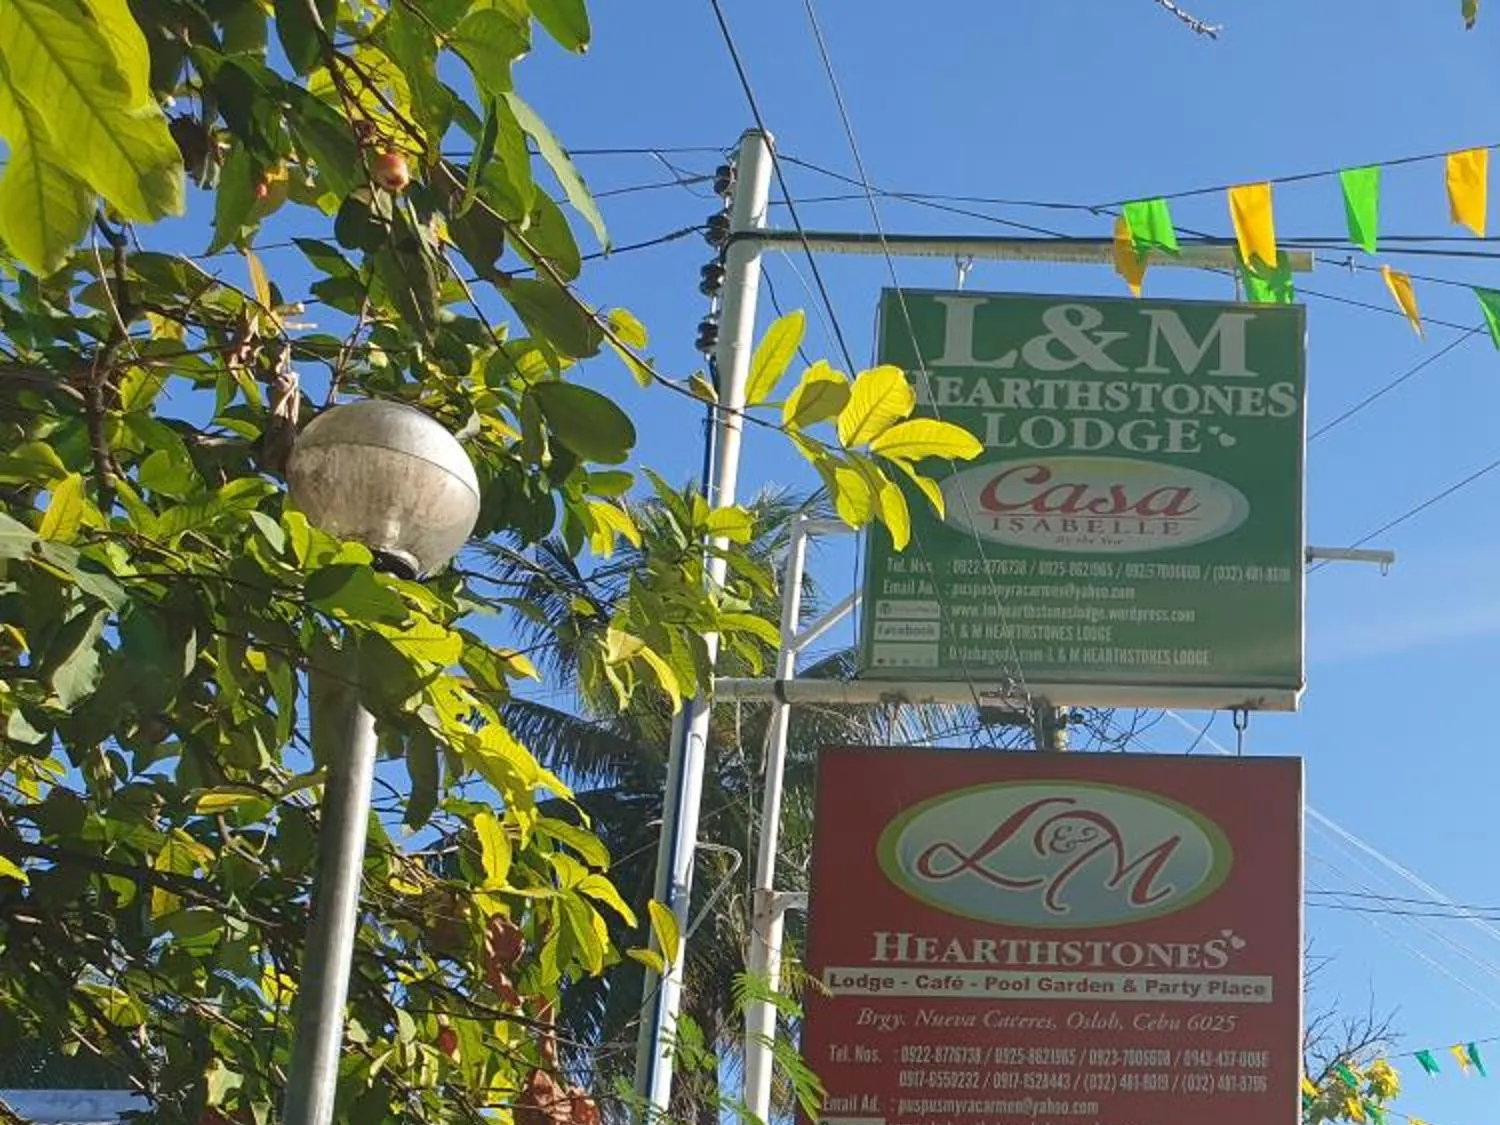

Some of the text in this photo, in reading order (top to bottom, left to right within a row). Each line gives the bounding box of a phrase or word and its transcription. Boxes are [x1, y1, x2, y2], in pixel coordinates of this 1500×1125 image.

[982, 412, 1200, 454] LODGE
[979, 465, 1202, 517] Casa
[991, 517, 1182, 536] ISABELLE
[883, 579, 915, 595] Email
[1077, 625, 1113, 643] LODGE
[1173, 649, 1211, 666] LODGE
[870, 932, 1229, 969] HEARTHSTONES
[829, 973, 895, 992] Lodge
[914, 974, 964, 991] Café
[984, 976, 1030, 992] Pool
[1038, 977, 1115, 994] Garden
[1122, 978, 1138, 994] &
[1145, 979, 1201, 998] Party
[1207, 980, 1267, 997] Place
[914, 1009, 977, 1029] Nueva
[1132, 1013, 1181, 1032] Cebu
[1187, 1014, 1240, 1034] 6025
[829, 1045, 851, 1062] Tel.
[854, 1046, 883, 1063] Nos.
[822, 1095, 859, 1112] Email
